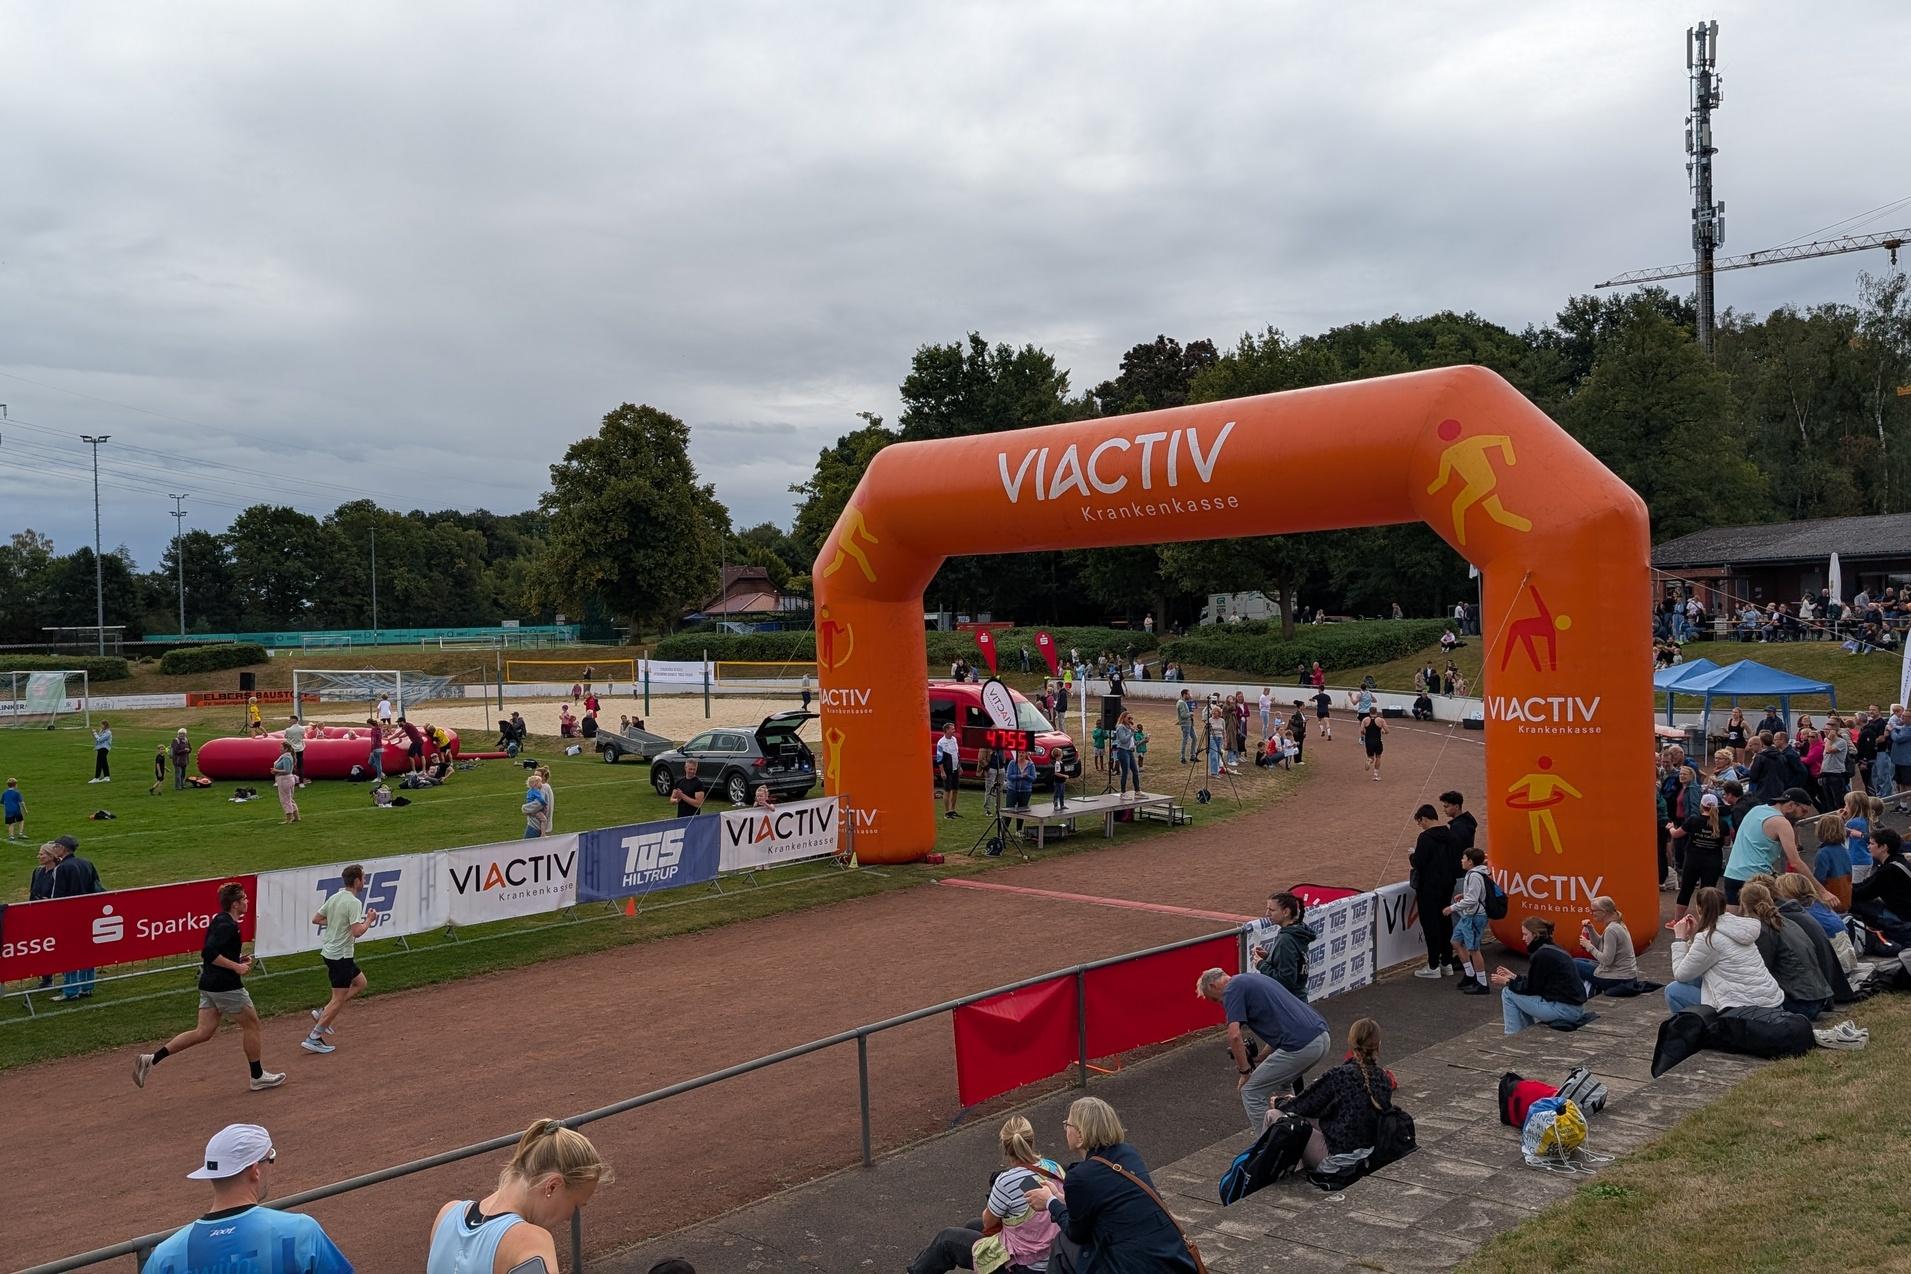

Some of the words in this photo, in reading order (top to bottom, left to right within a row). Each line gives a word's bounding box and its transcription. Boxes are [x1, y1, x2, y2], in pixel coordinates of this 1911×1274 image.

[998, 421, 1236, 504] VIACTIV
[1081, 494, 1240, 523] Krankenkasse
[819, 687, 872, 706] IACTIV
[1488, 696, 1601, 722] VIACTIV
[1518, 724, 1602, 735] Krankenkasse
[726, 804, 834, 847] VIACTIV
[767, 836, 834, 854] Krankenkasse
[449, 850, 576, 895] VIACTIV
[622, 865, 679, 888] HILTRUP
[1491, 866, 1604, 901] VIACTIV
[498, 882, 574, 902] Krankenkasse
[1521, 900, 1593, 915] Krankenkas
[0, 937, 56, 958] asse
